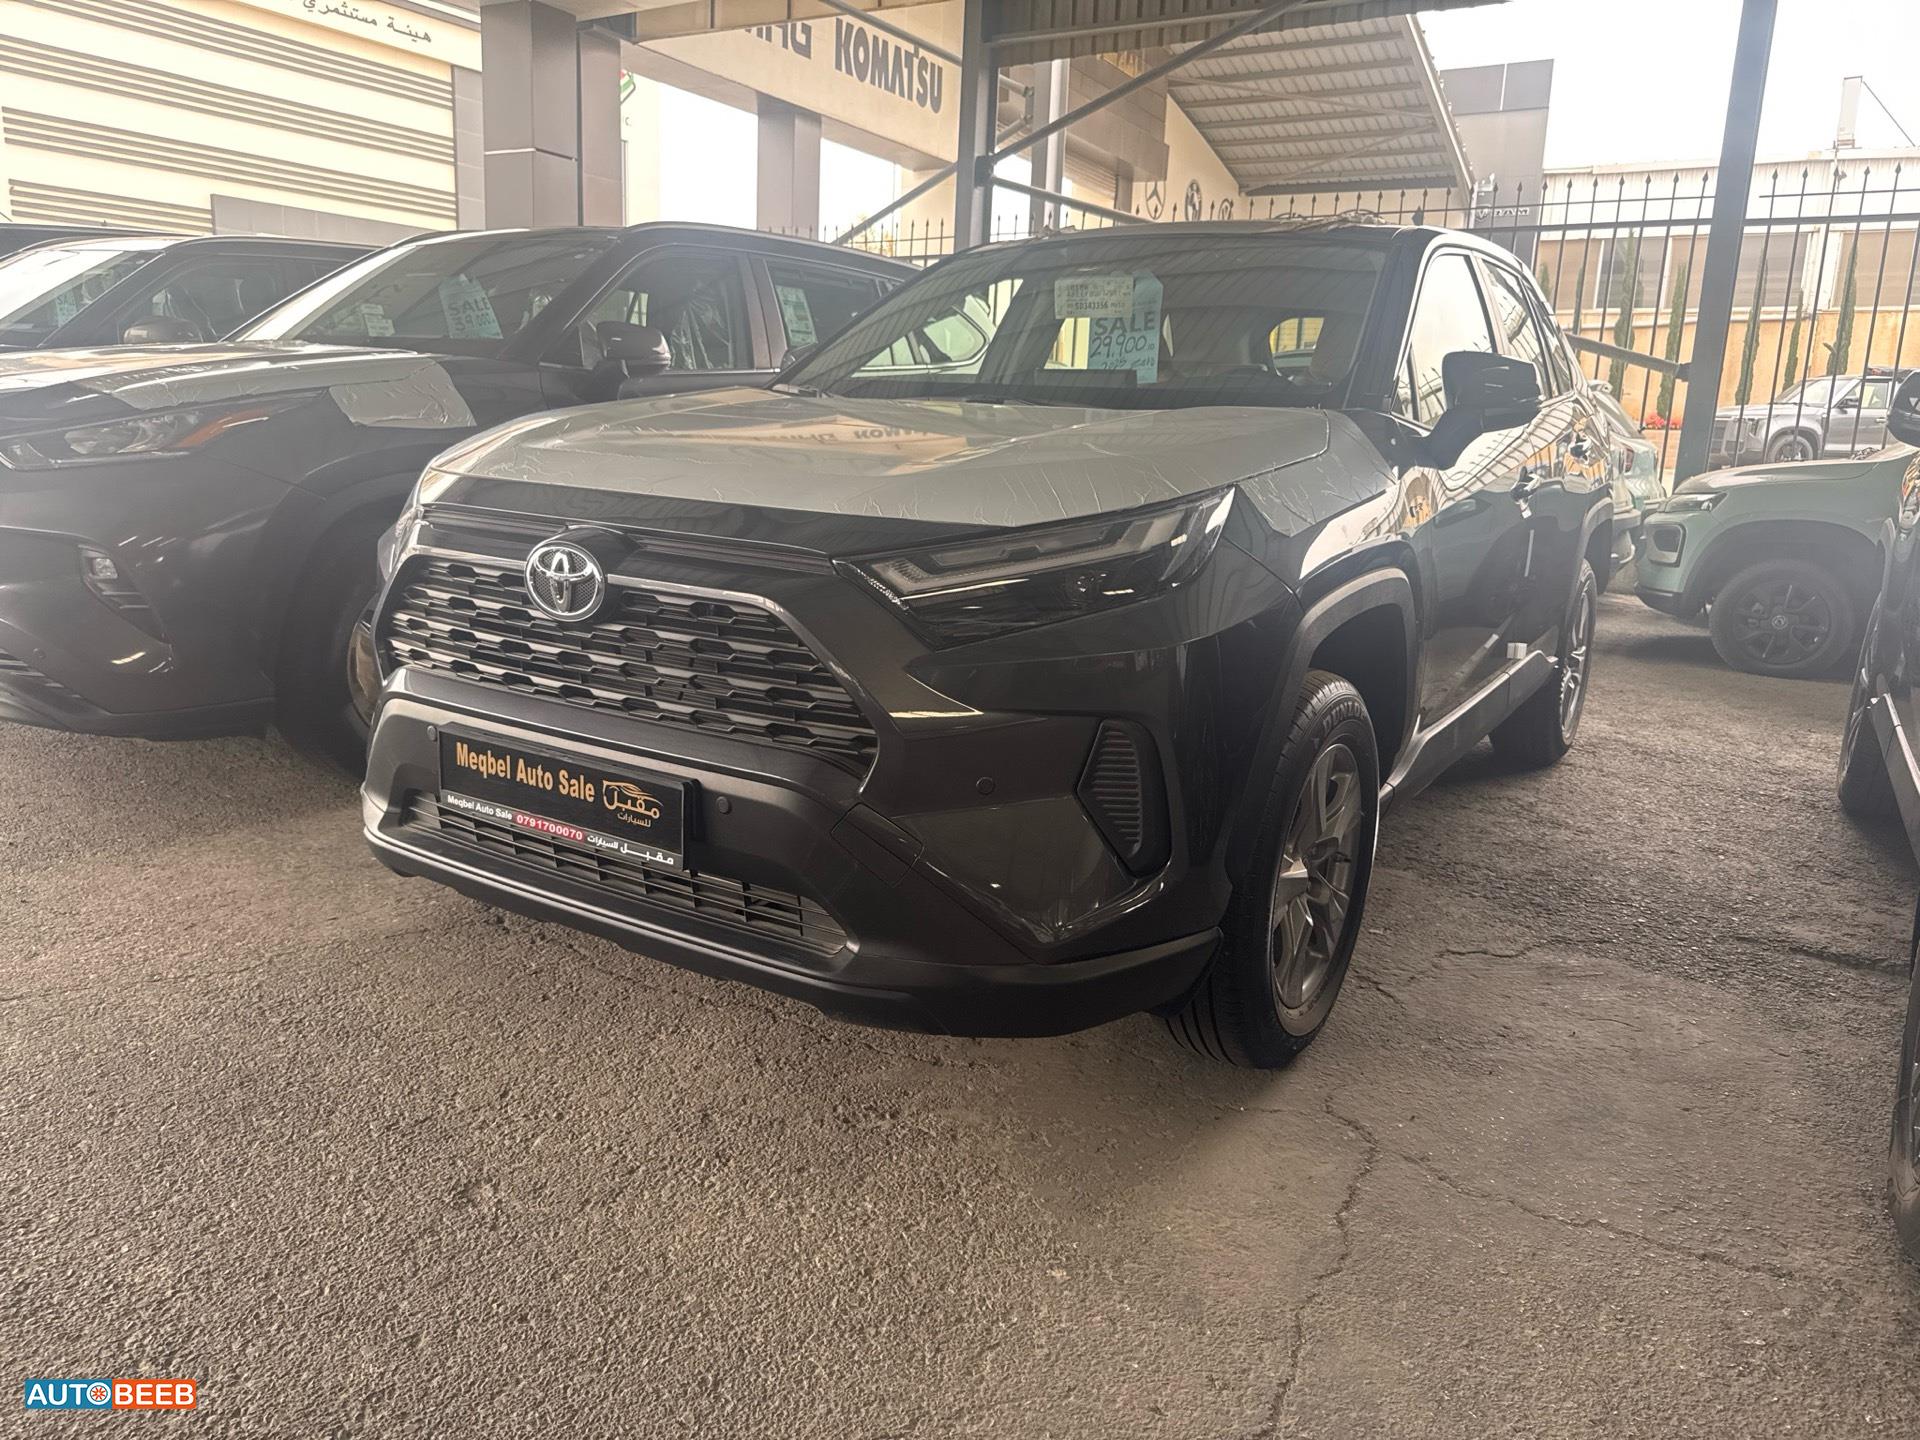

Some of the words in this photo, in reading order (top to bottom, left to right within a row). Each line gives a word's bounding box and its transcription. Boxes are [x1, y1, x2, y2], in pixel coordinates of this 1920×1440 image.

[834, 16, 944, 114] KOMATSU
[1094, 311, 1156, 336] SALE
[456, 742, 511, 779] Meqbel
[516, 758, 554, 790] Auto
[558, 769, 596, 803] Sale
[447, 794, 475, 810] Meqbel
[475, 802, 495, 815] Auto
[495, 807, 513, 820] Sale
[516, 814, 584, 841] 0791700070
